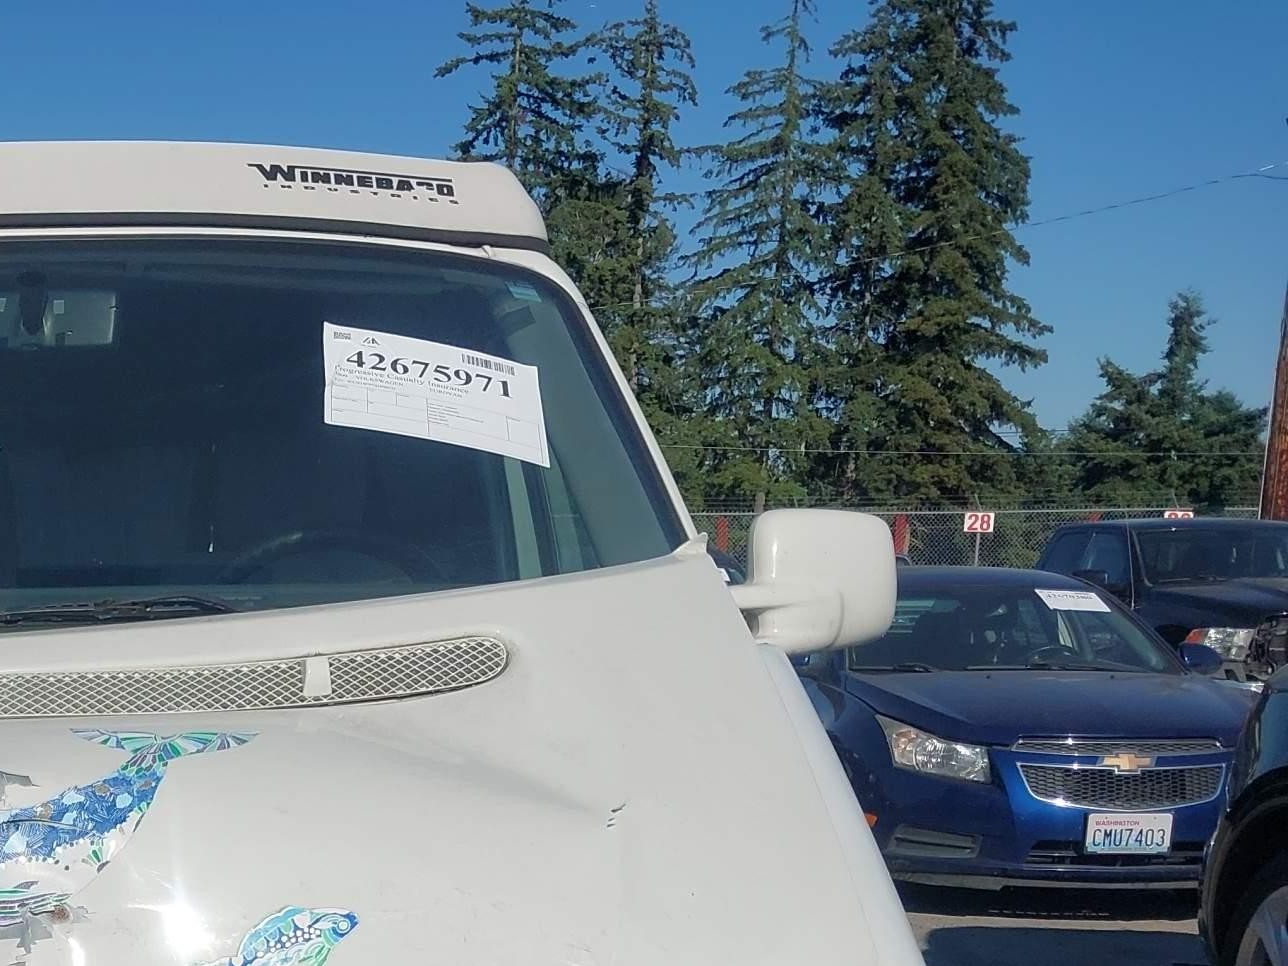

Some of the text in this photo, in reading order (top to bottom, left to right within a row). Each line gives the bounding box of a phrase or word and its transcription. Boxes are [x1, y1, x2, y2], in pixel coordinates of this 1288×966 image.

[263, 183, 460, 205] INDUSTRIES
[334, 364, 385, 379] Progressive
[346, 350, 512, 398] 42675971
[966, 514, 991, 530] 28
[1092, 828, 1166, 847] CMU7403
